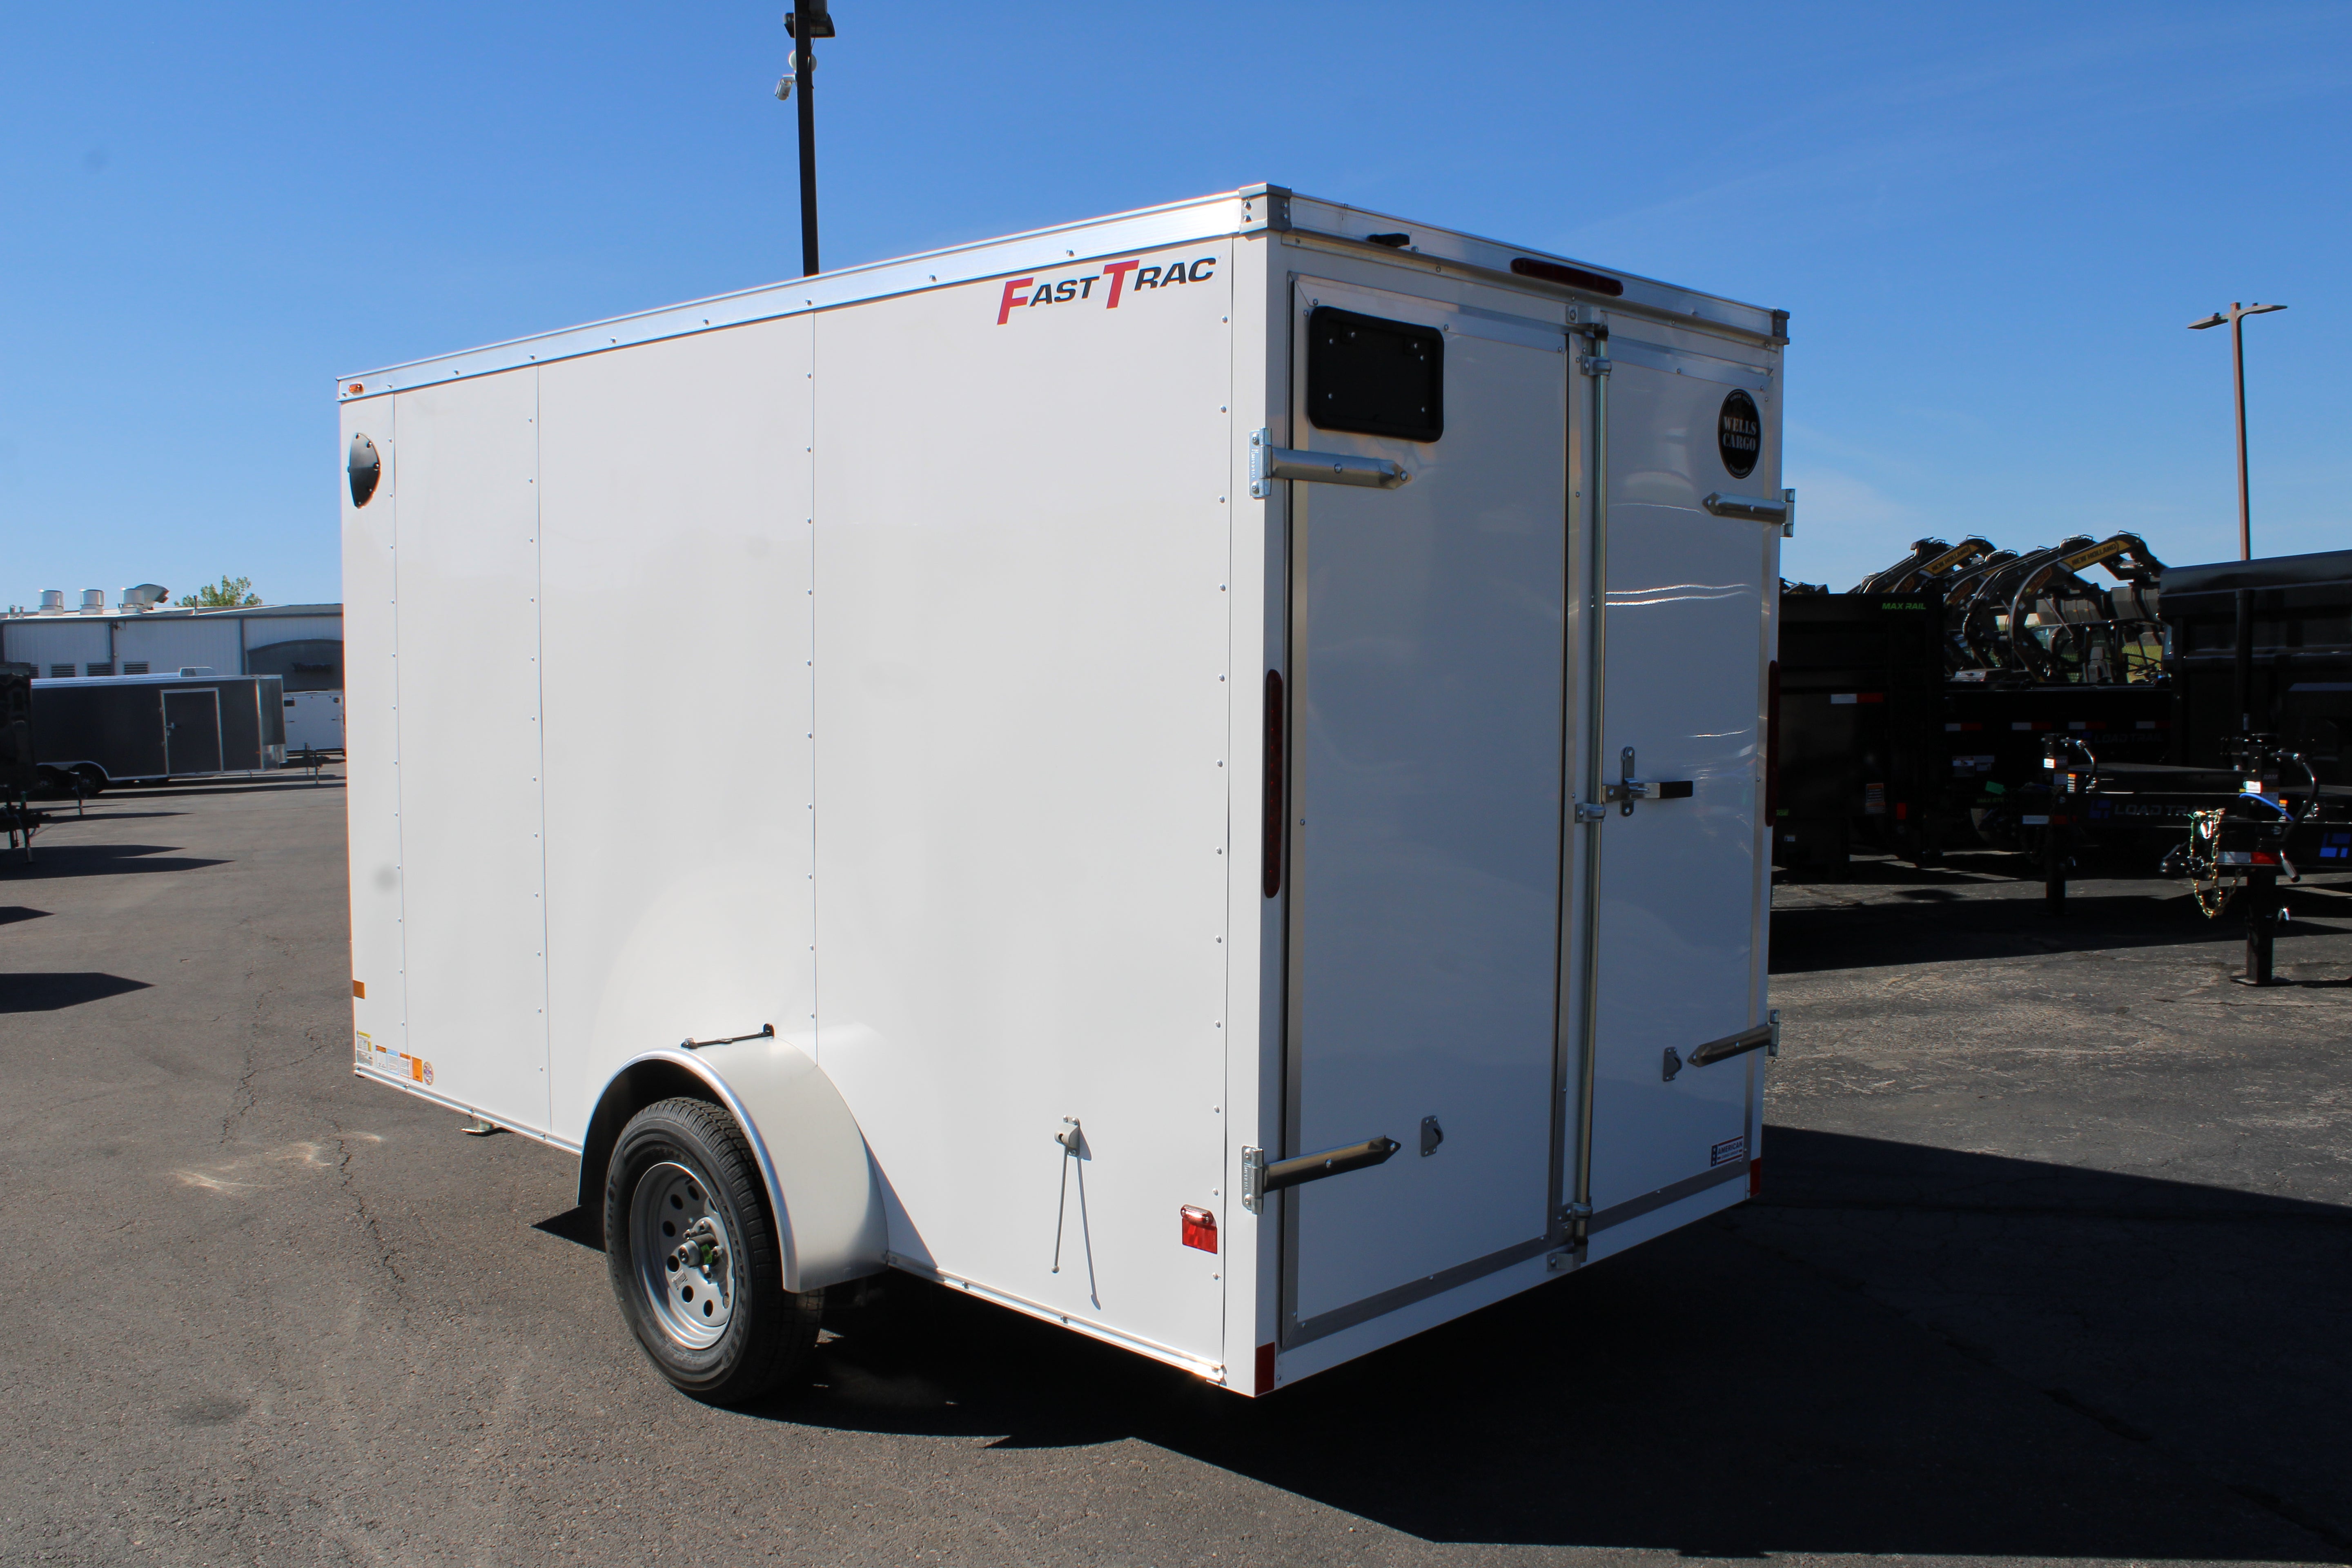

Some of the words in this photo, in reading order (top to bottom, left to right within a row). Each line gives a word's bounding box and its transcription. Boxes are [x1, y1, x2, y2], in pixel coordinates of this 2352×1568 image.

[997, 276, 1100, 325] FAST
[1103, 258, 1216, 310] TRAC
[1724, 416, 1757, 436] WELLS
[1722, 432, 1756, 452] CARGO
[2087, 543, 2117, 560] HOLLAND
[2114, 804, 2163, 815] LOAD
[1718, 1140, 1743, 1154] AMERICAN
